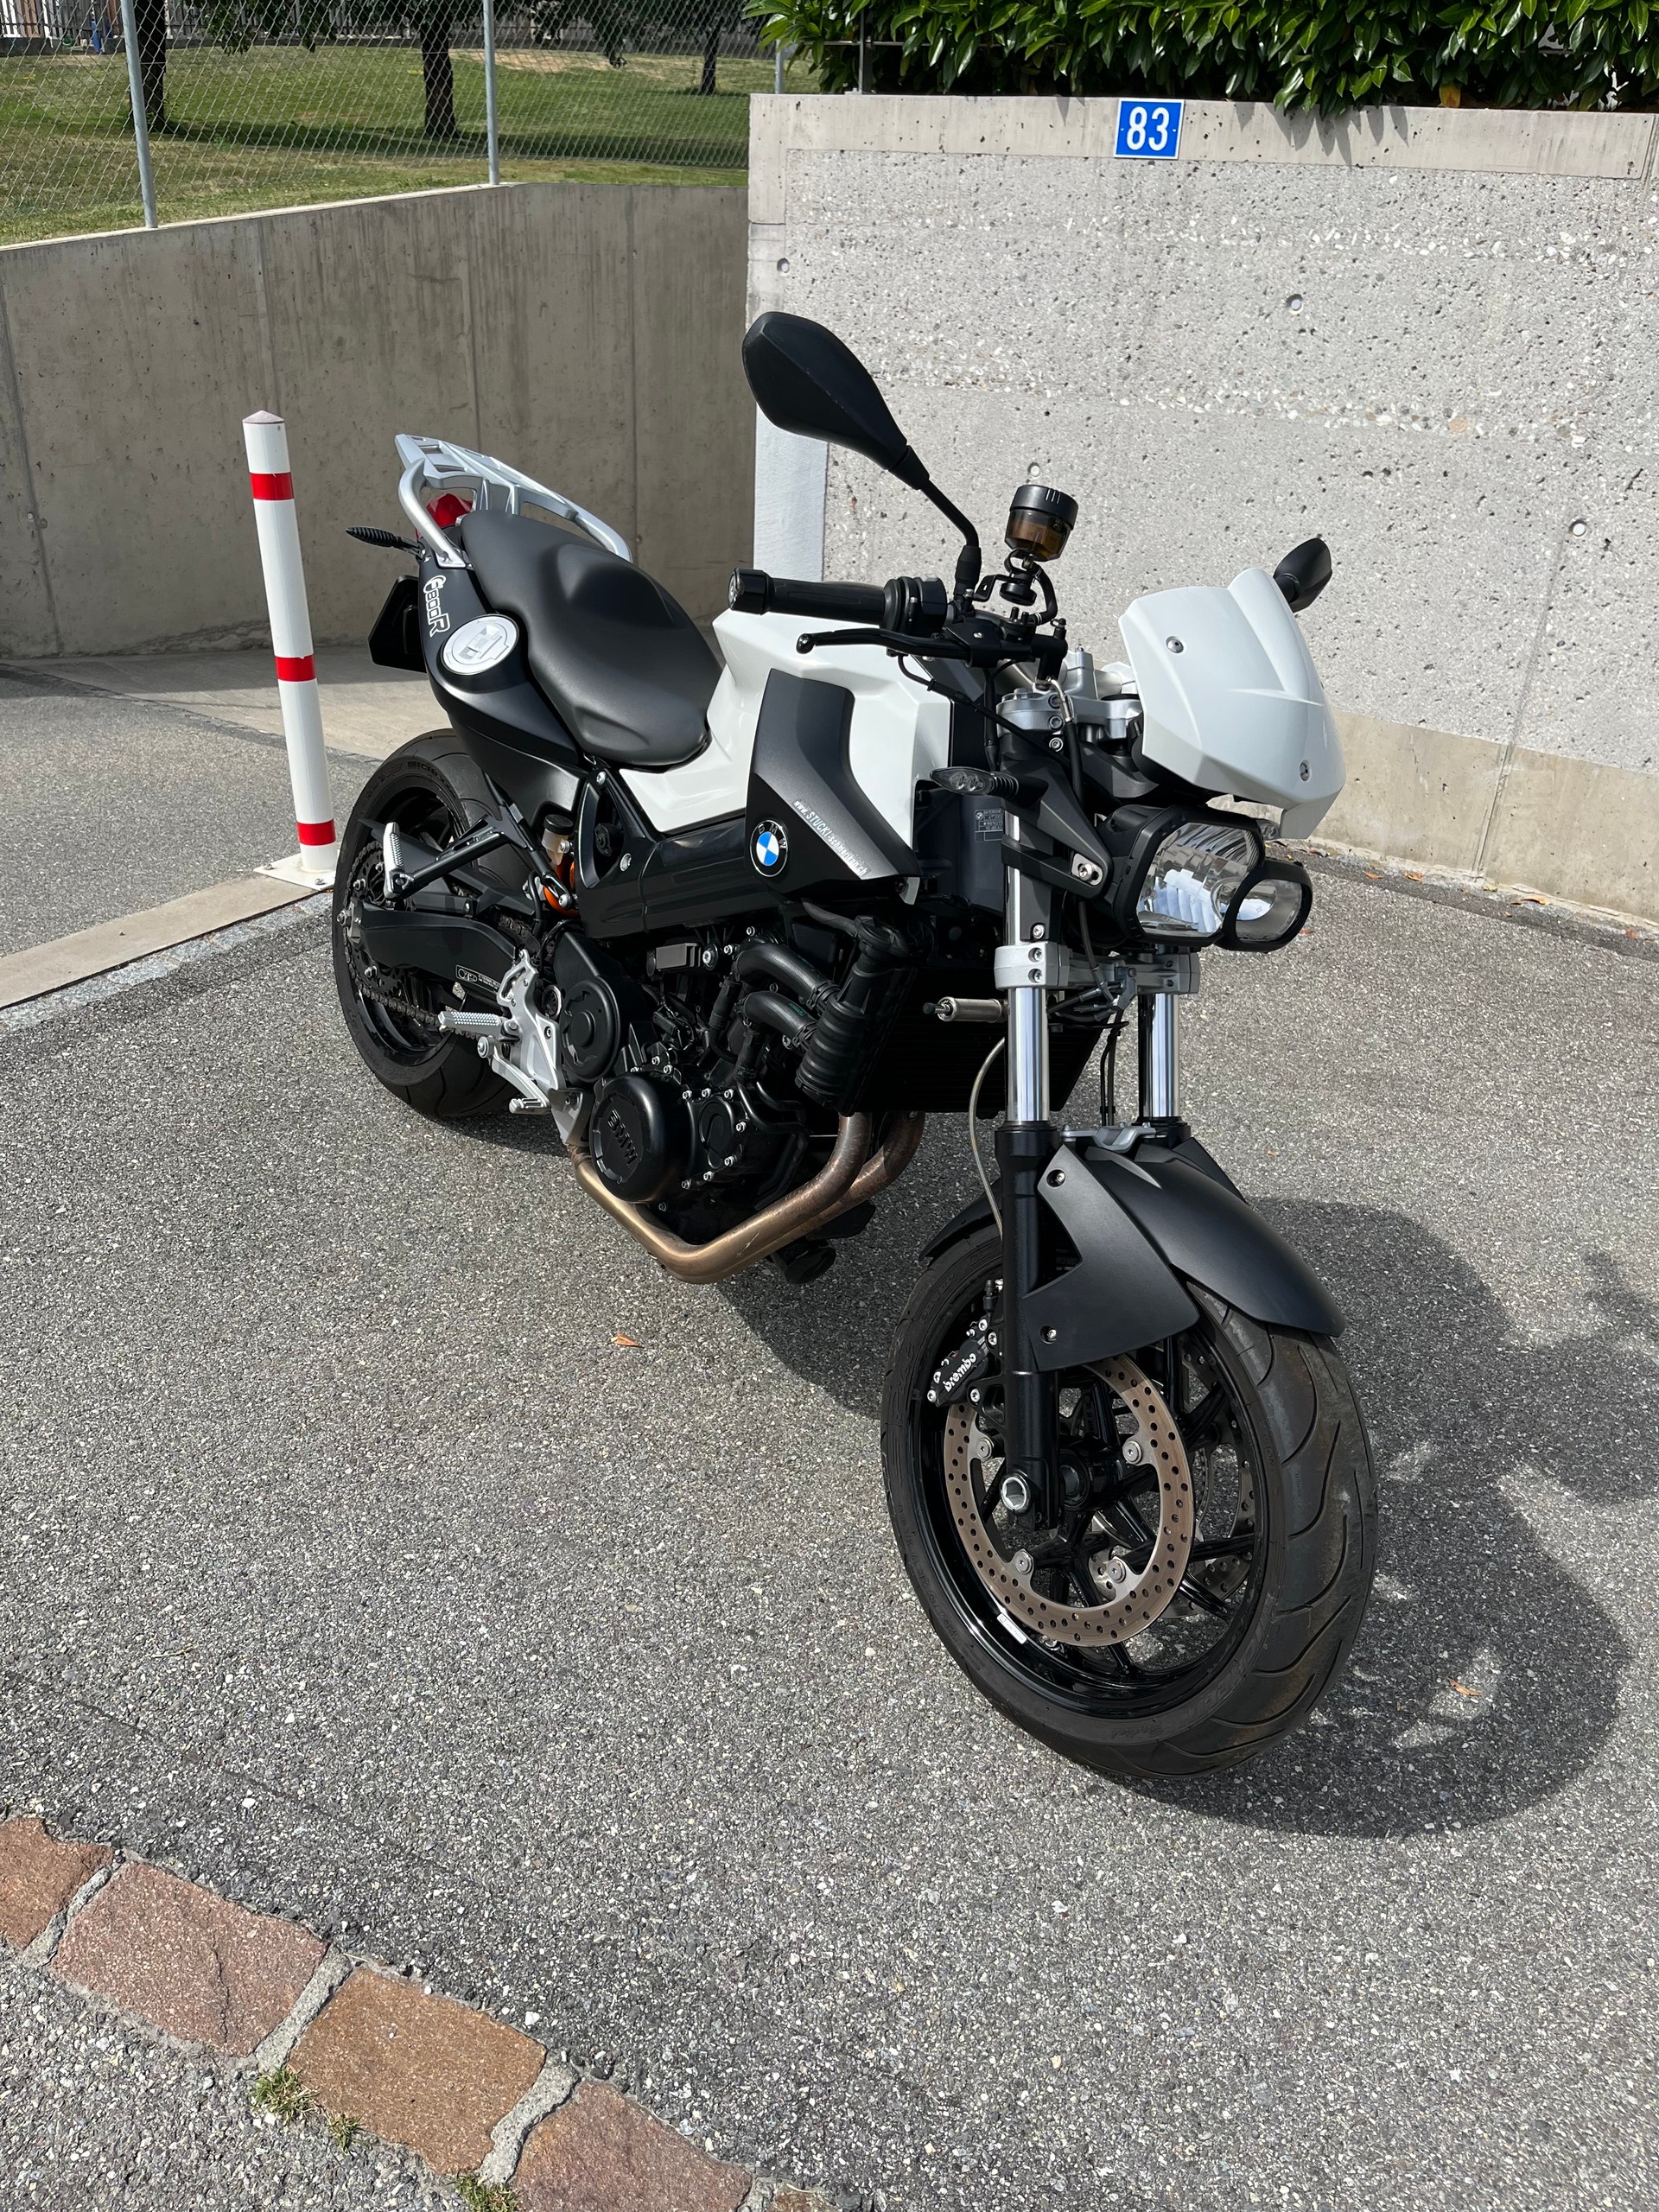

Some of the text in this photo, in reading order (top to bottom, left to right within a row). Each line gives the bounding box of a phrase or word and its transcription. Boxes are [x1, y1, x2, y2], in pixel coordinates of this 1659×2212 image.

[1126, 106, 1170, 151] 83
[757, 823, 787, 849] BMW
[607, 1109, 639, 1165] BMW
[942, 1352, 977, 1393] brembo
